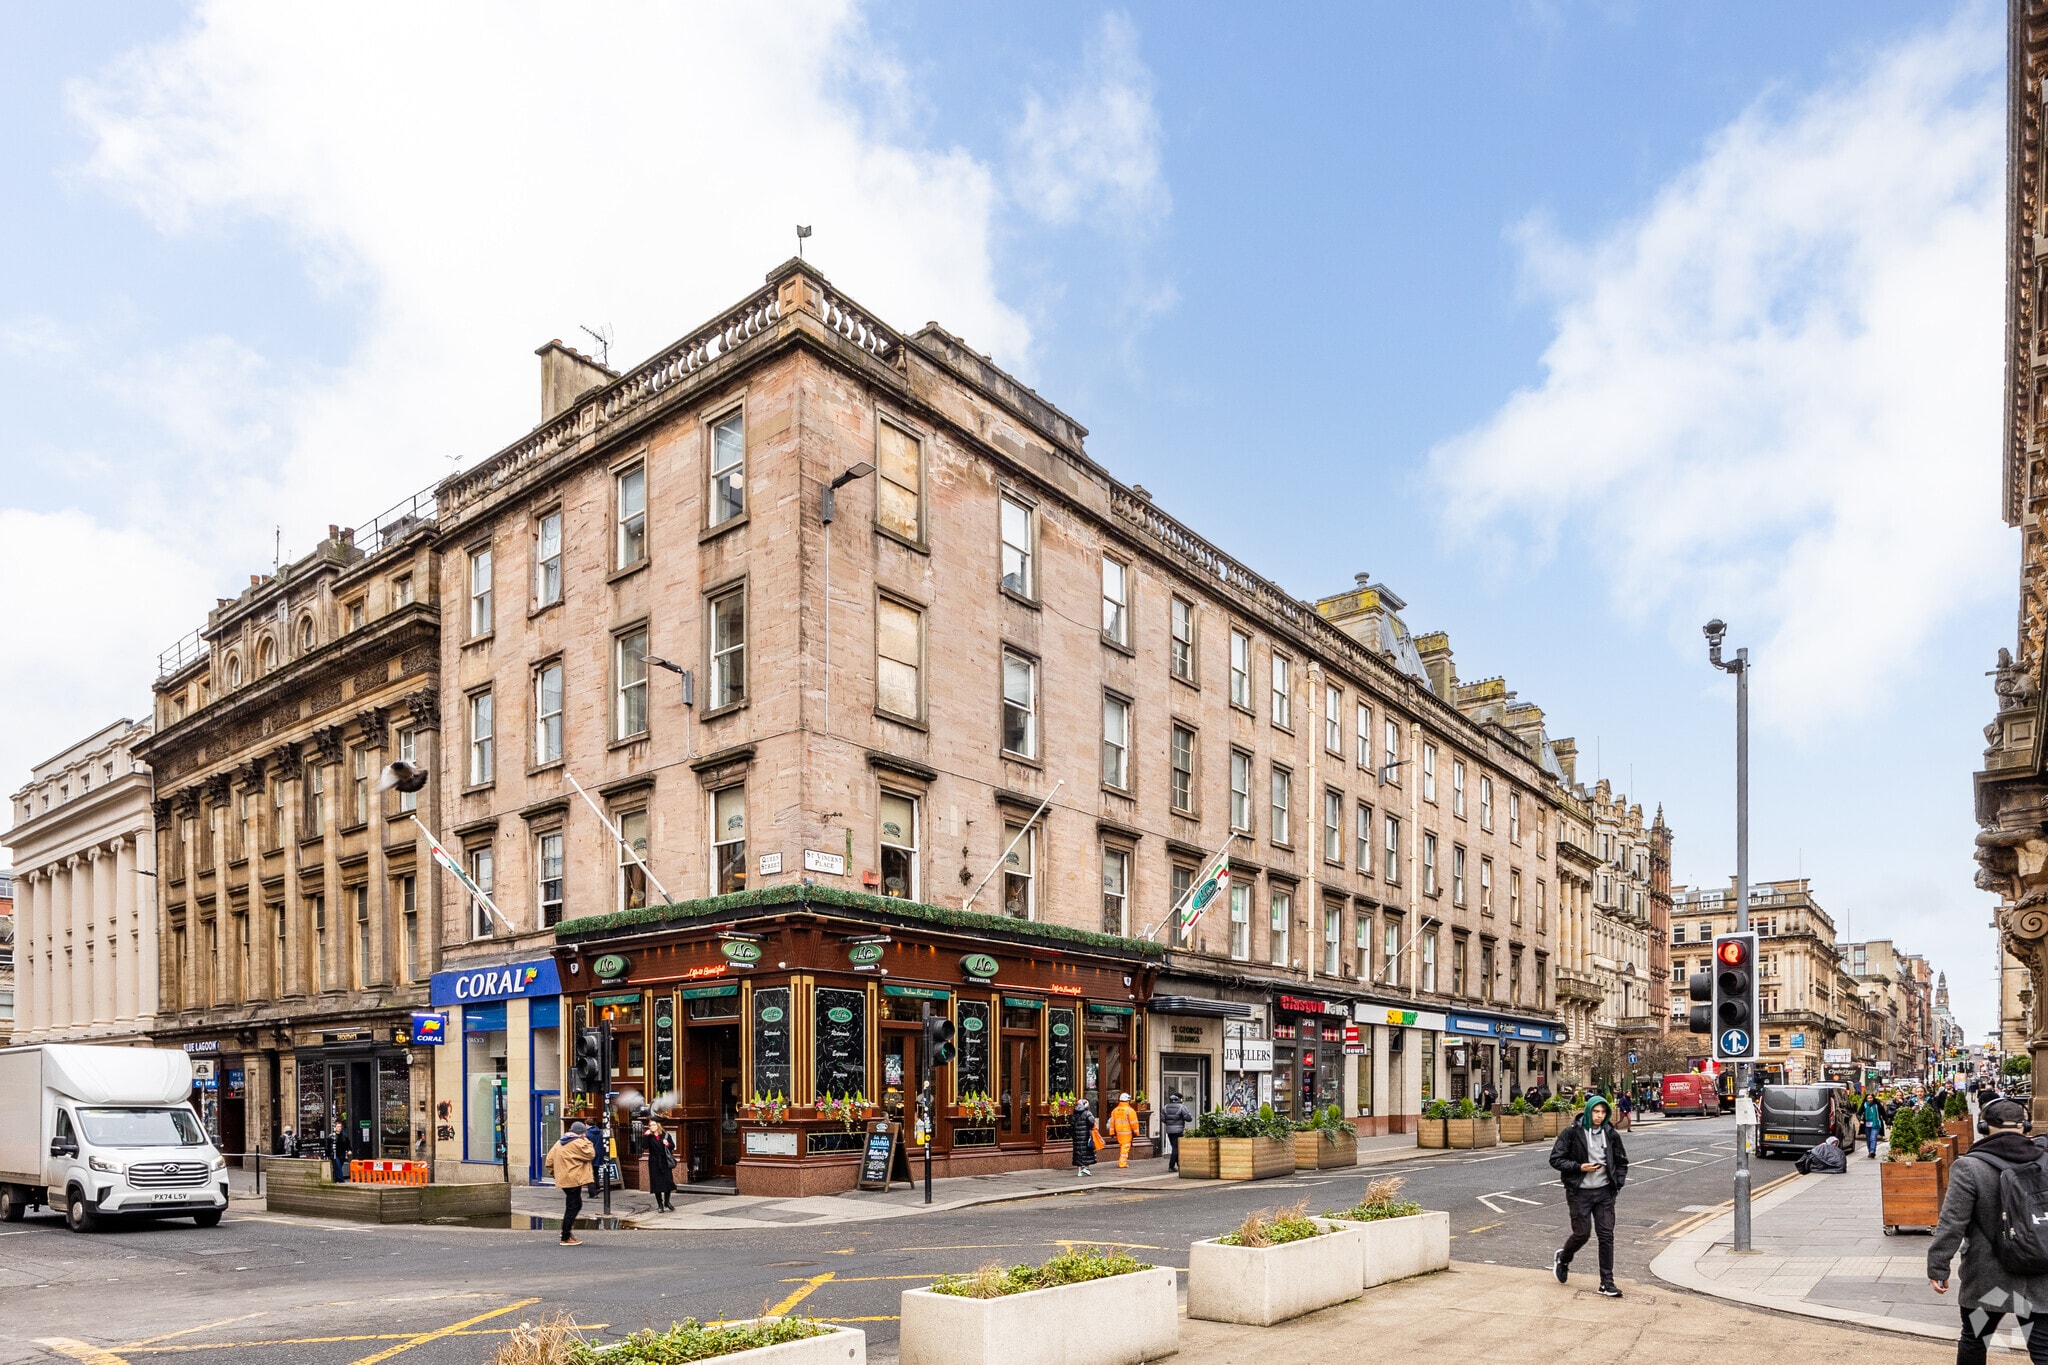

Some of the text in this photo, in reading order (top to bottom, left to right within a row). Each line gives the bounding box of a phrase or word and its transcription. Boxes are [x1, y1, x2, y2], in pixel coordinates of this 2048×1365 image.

[815, 860, 834, 868] PLACE
[816, 854, 842, 864] VINCENT
[456, 968, 525, 998] CORAL
[1386, 1010, 1418, 1026] SUBWAY
[1225, 1048, 1271, 1061] JEWELLERS
